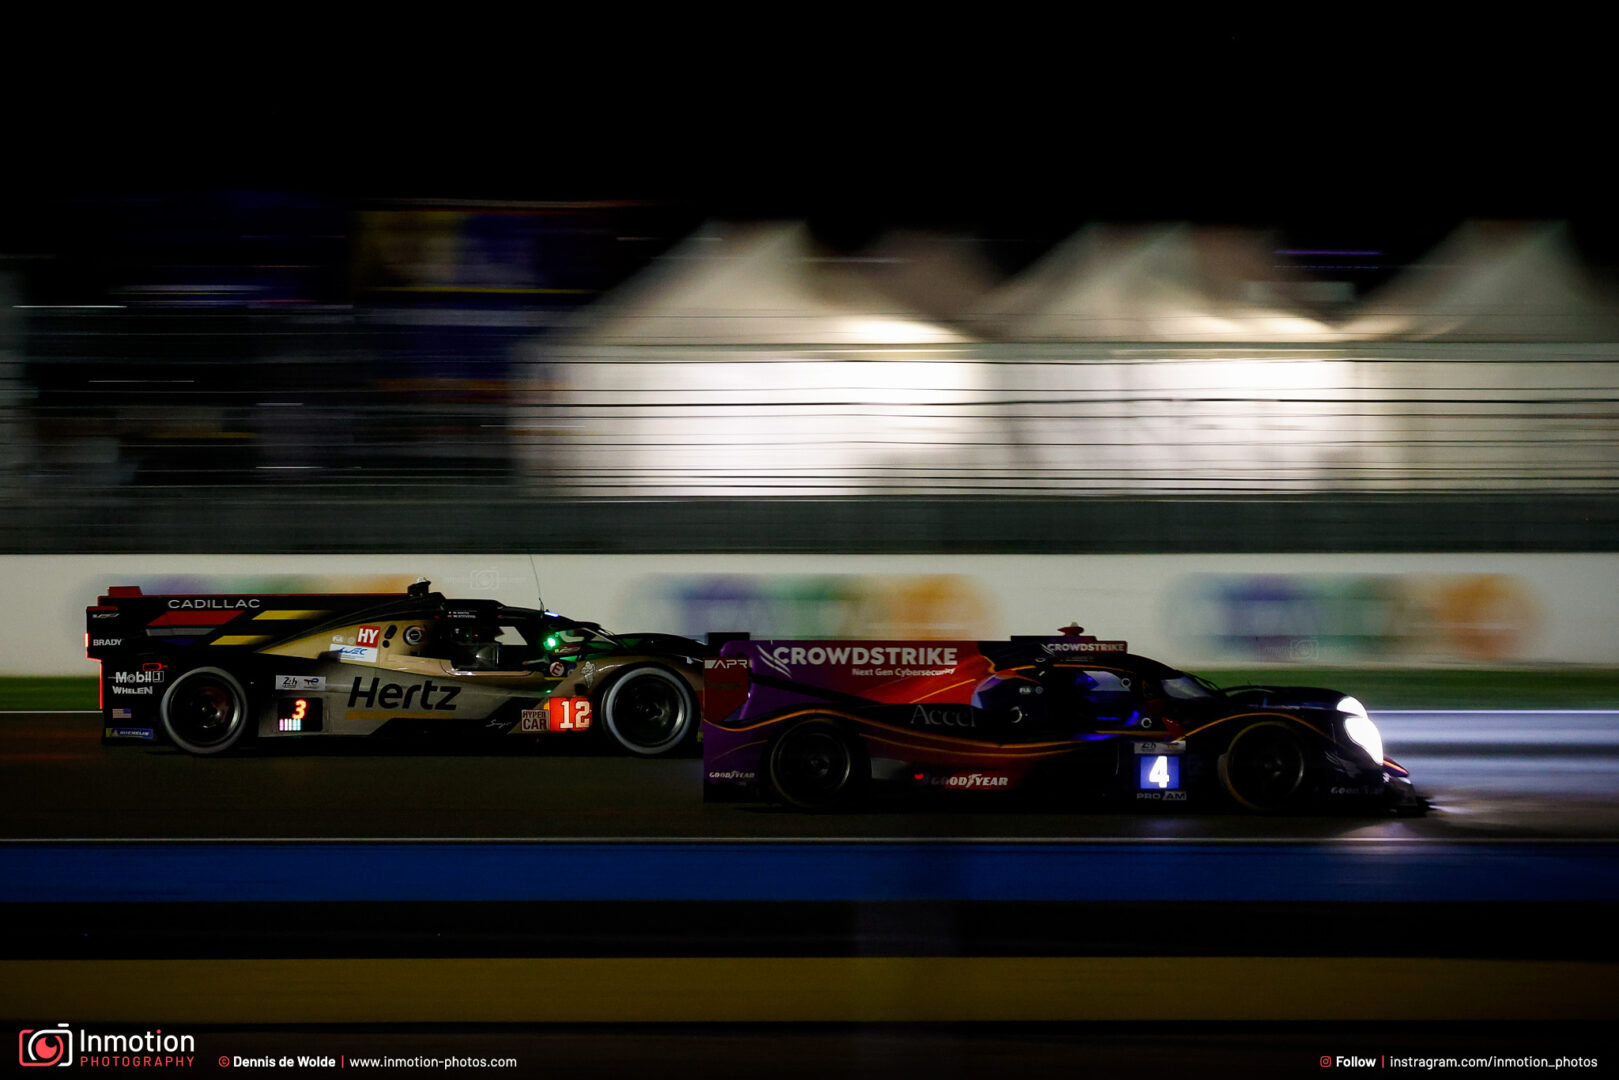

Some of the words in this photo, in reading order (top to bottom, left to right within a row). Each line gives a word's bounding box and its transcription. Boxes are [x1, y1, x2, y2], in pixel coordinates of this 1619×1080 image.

[168, 599, 261, 609] CADILLAC
[357, 627, 380, 644] HY
[1046, 643, 1126, 652] CROWDSTRIKE
[772, 647, 958, 665] CROWDSTRIKE
[115, 671, 151, 683] Mobil
[852, 668, 873, 676] Next
[875, 668, 893, 676] Gen
[895, 668, 956, 678] Cybersecurity
[347, 676, 461, 710] Hertz
[292, 699, 307, 720] 3
[560, 701, 590, 729] 12
[910, 704, 977, 728] Accel
[523, 719, 547, 730] CAR
[709, 770, 755, 779] GOODYEAR
[1149, 755, 1170, 788] 4
[930, 773, 1009, 789] GOODYEAR
